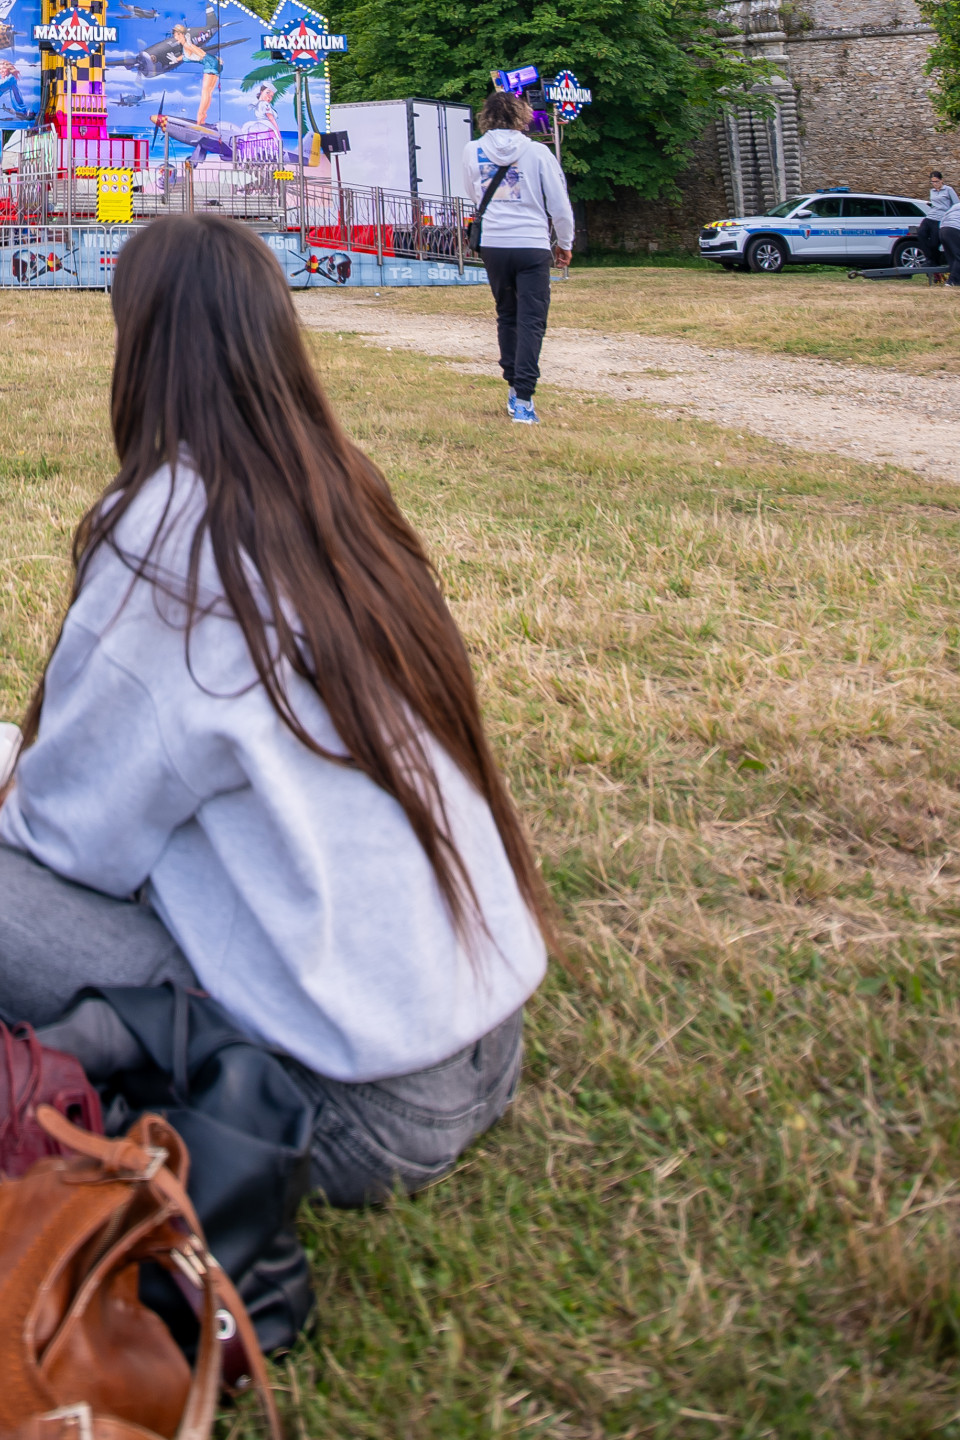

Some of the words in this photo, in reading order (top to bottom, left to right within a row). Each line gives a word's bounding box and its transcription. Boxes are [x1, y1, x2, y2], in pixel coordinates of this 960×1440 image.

[34, 25, 117, 42] MAXXIMUM
[264, 35, 345, 50] MAXXIMUM
[549, 86, 593, 103] MAXXIMUM
[268, 235, 298, 250] 45m
[389, 267, 413, 279] T2
[427, 267, 488, 282] SORTIE
